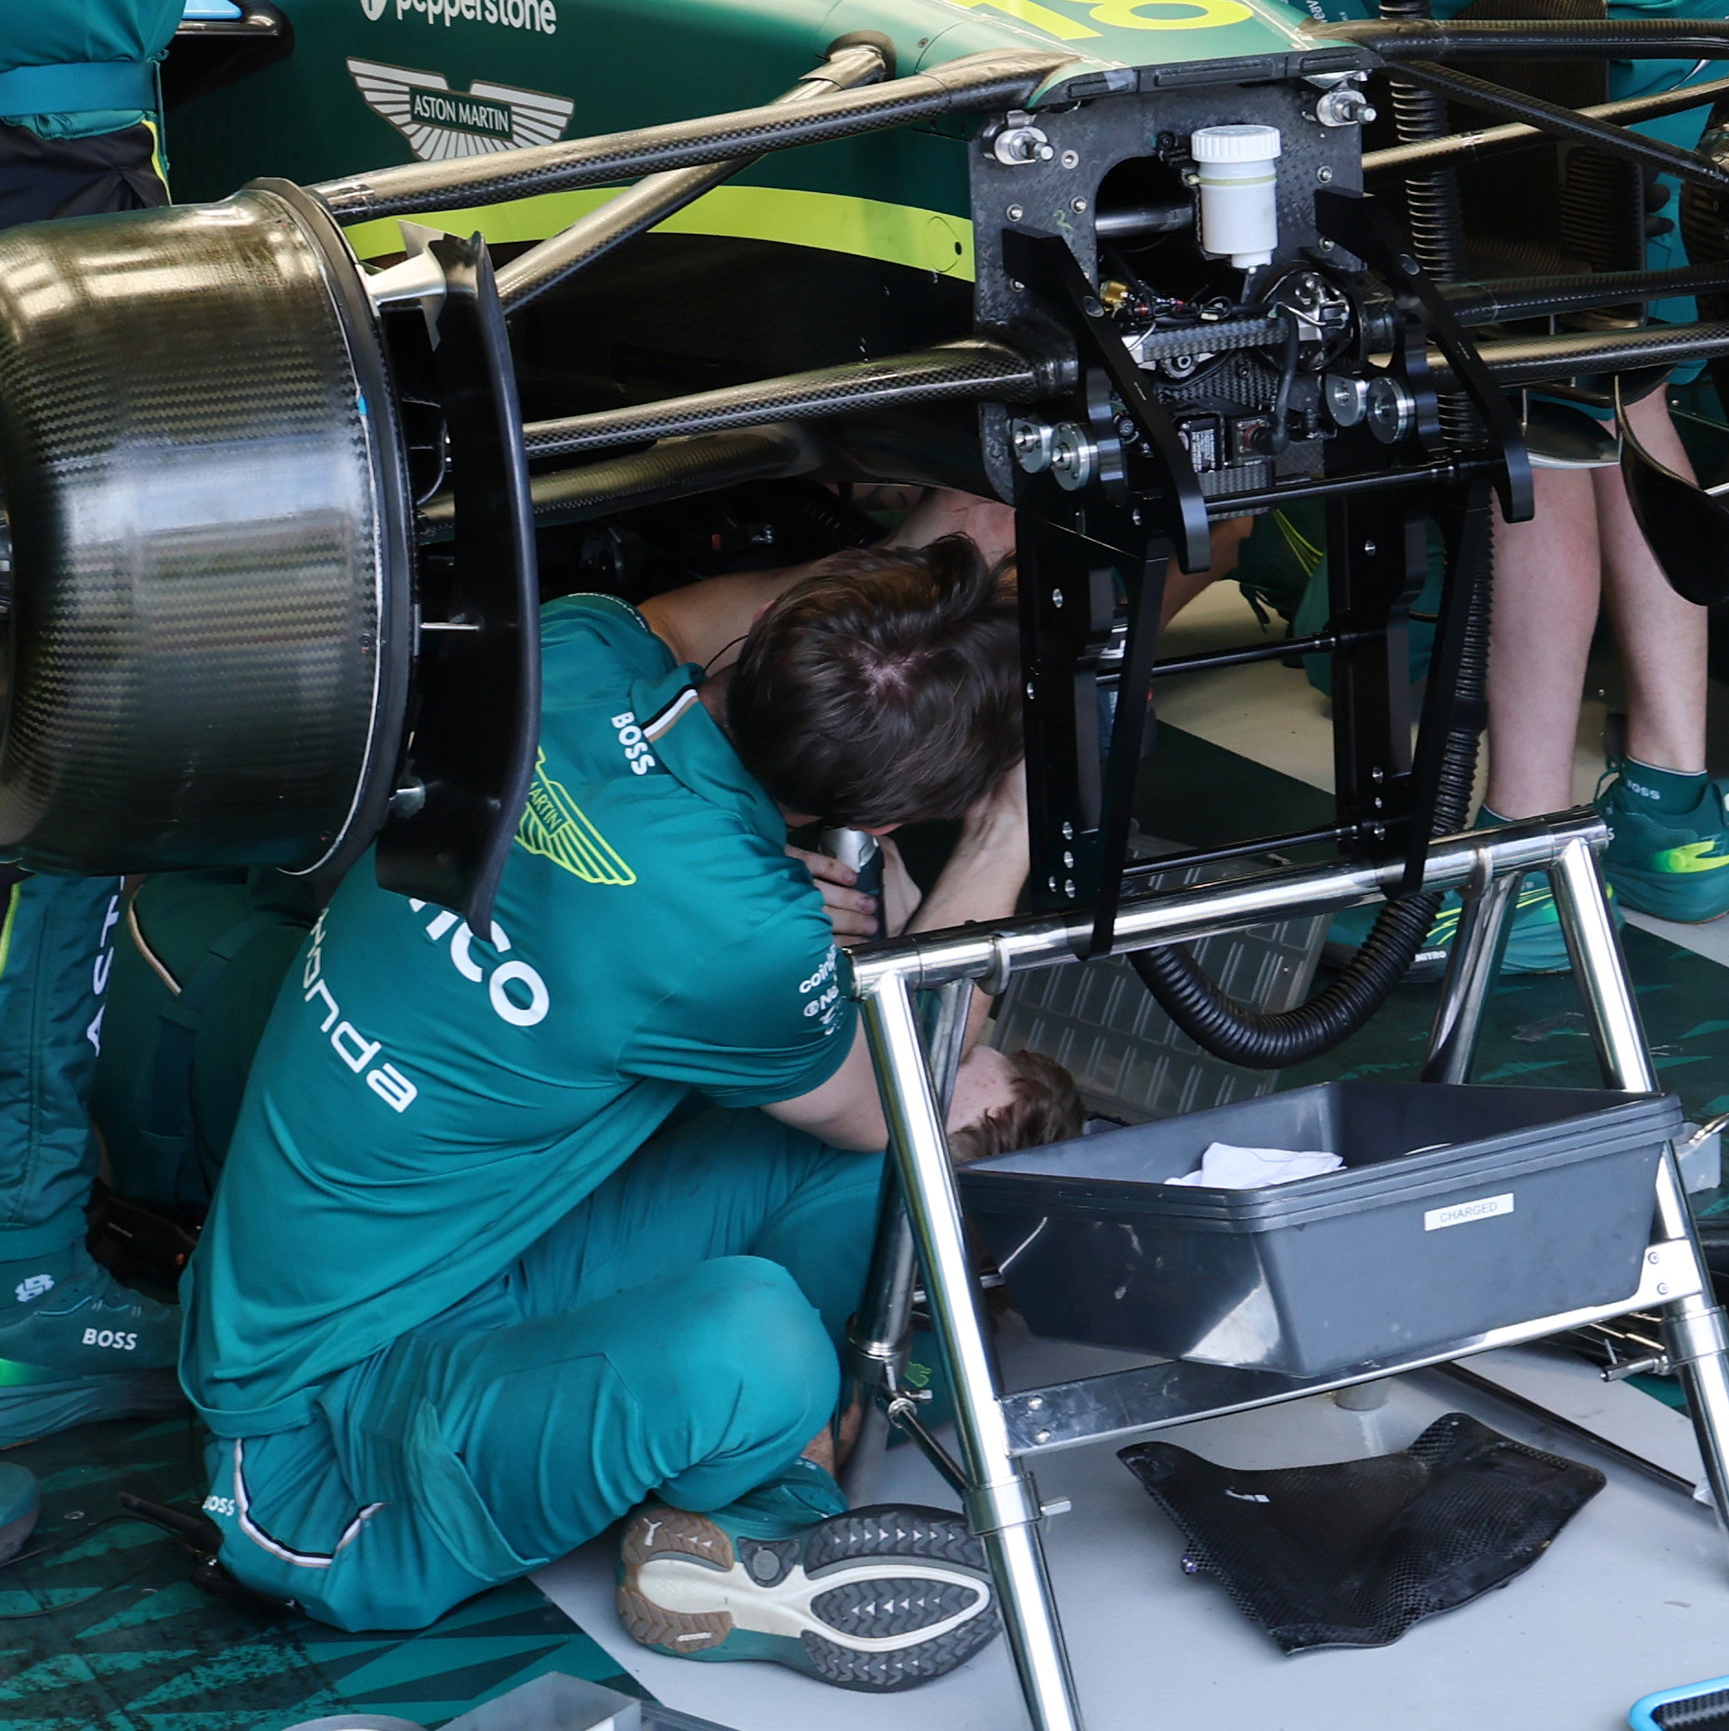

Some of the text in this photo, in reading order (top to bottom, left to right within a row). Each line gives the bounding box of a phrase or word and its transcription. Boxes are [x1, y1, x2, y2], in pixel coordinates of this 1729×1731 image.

[413, 94, 510, 133] ASTON MARTIN
[611, 711, 657, 777] BOSS
[1439, 1201, 1498, 1223] CHARGED
[82, 1327, 139, 1352] BOSS
